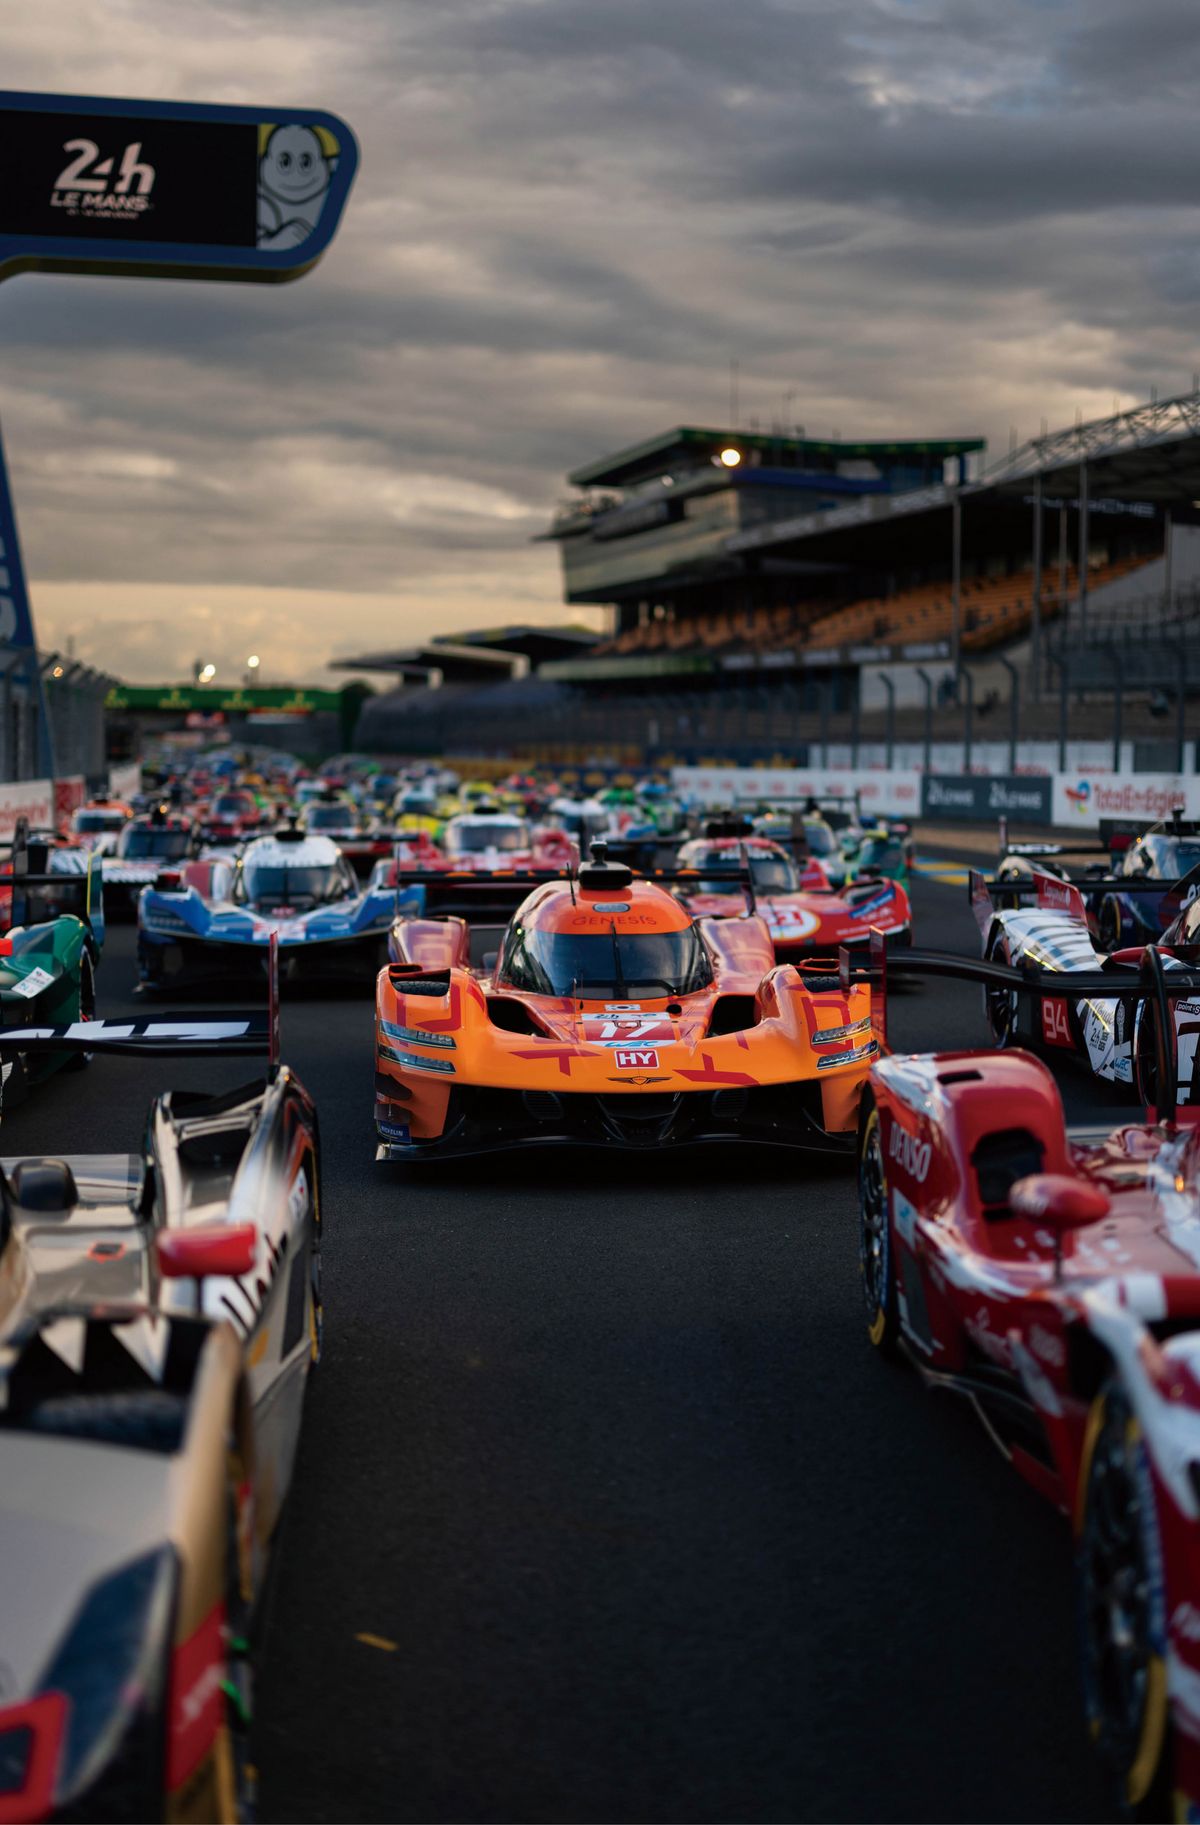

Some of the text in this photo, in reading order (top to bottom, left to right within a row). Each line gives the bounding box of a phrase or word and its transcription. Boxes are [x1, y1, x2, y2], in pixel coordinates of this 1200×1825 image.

[54, 138, 156, 195] 24h
[50, 191, 150, 212] LE MANS
[572, 915, 657, 926] GENESIS
[600, 1021, 661, 1039] 17
[1043, 1001, 1071, 1042] 94
[618, 1052, 654, 1065] HY
[889, 1121, 932, 1183] DENSO
